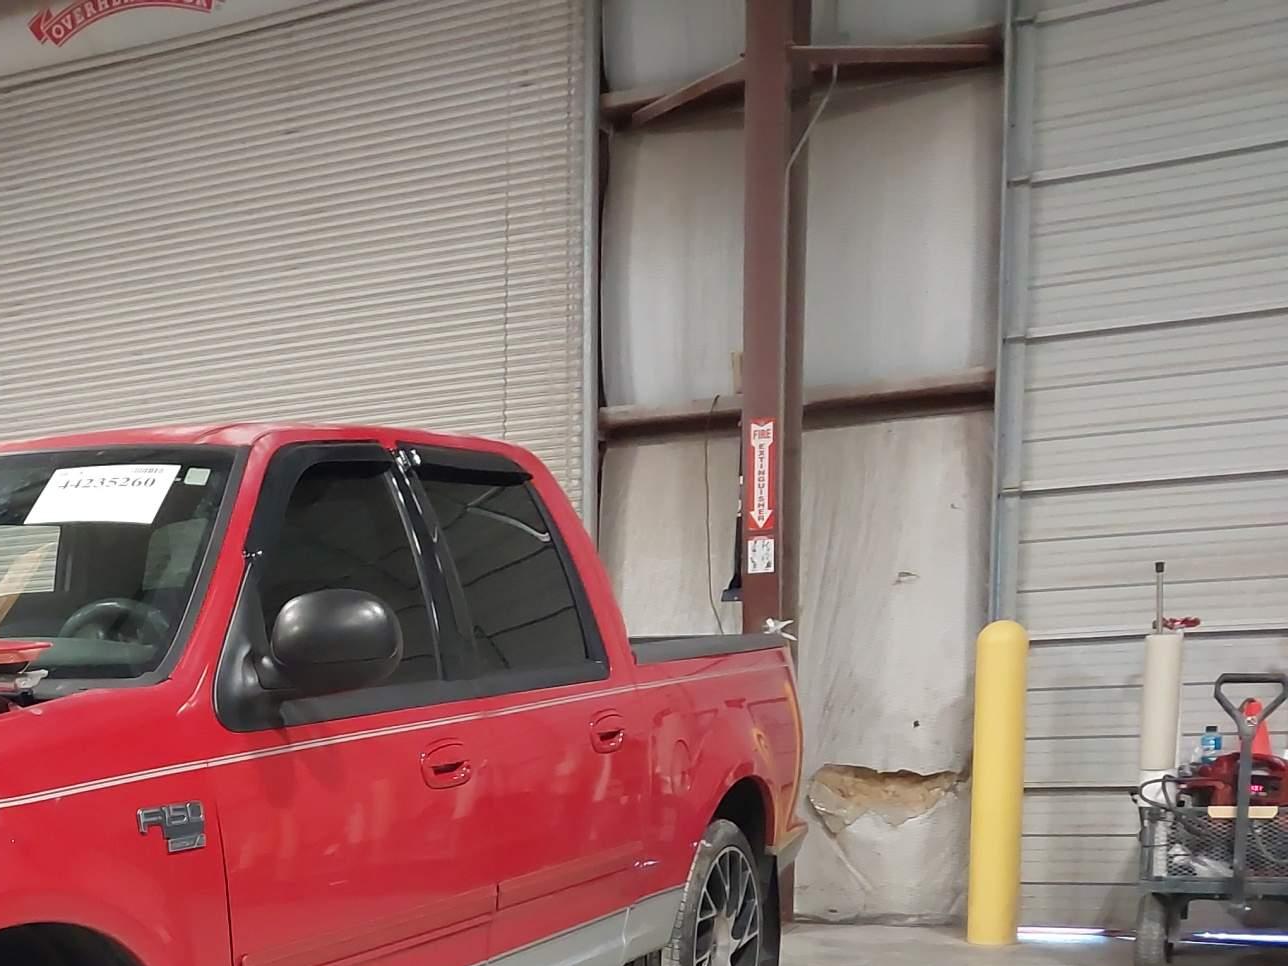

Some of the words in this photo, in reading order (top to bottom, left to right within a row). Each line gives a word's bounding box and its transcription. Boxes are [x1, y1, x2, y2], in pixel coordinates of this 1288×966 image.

[753, 429, 772, 440] FIRE
[58, 477, 156, 489] 44235260
[756, 443, 765, 521] EXTINGUISHER
